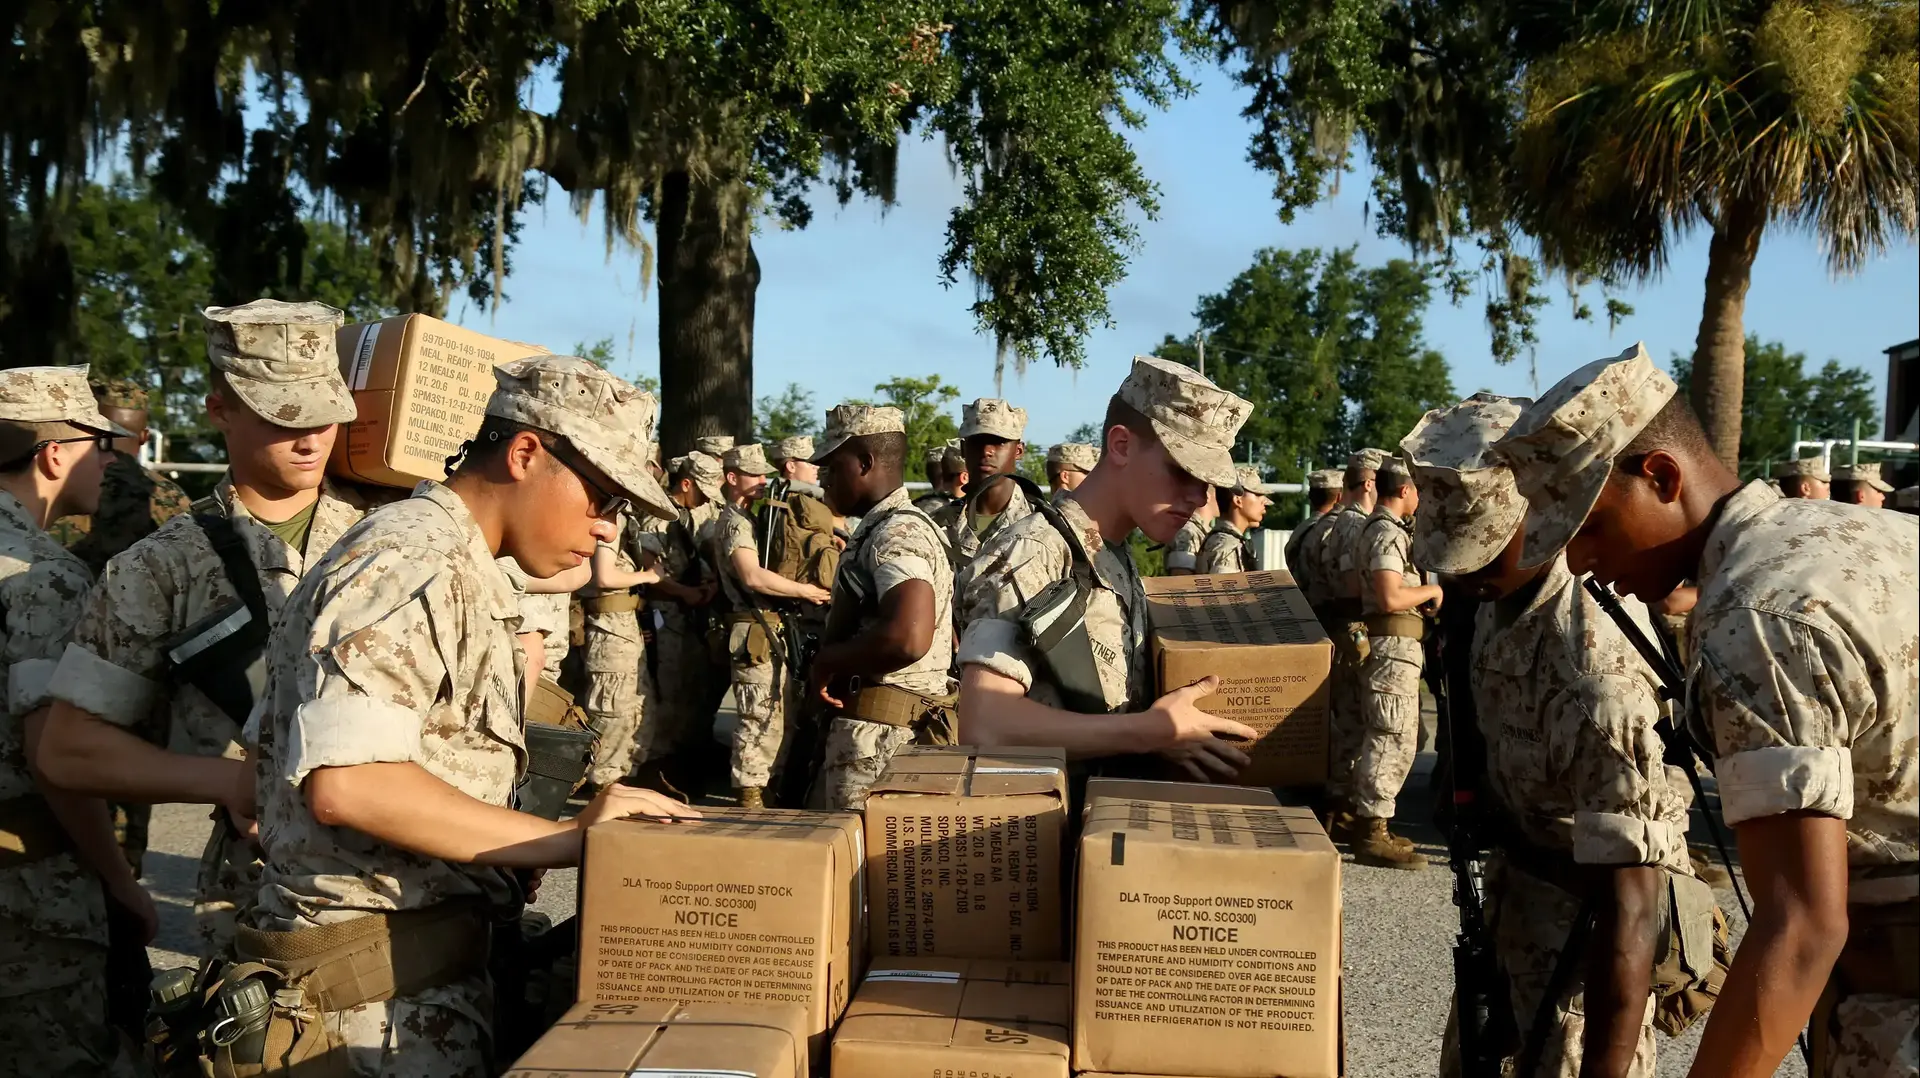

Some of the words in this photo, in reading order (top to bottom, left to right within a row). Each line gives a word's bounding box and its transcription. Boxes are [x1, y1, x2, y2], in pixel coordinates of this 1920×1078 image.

[422, 333, 495, 361] 8970-00-149-1094
[420, 347, 443, 361] MEAL,
[446, 354, 472, 368] READY
[477, 363, 486, 372] TO
[418, 361, 428, 370] 12
[429, 364, 455, 378] MEALS
[455, 372, 468, 382] A/A
[415, 375, 428, 386] WT.
[430, 379, 448, 391] 20.6
[458, 387, 470, 397] CU.
[474, 391, 489, 403] 0.8
[410, 403, 447, 421] SOPAKCO,
[449, 413, 465, 425] INC.
[406, 431, 421, 442] U.S.
[408, 417, 445, 435] MULLINS,
[447, 427, 462, 438] S.C.
[903, 817, 913, 836] U.S.
[973, 816, 984, 835] WT.
[990, 816, 1001, 829] 12
[921, 817, 932, 865] MULLINS,
[938, 816, 949, 864] SOPAKCO,
[973, 835, 984, 857] 20.6
[990, 829, 1001, 864] MEALS
[886, 817, 897, 885] COMMERCIAL
[956, 816, 967, 913] SPM3S1-12-D-Z108
[1009, 851, 1019, 883] READY
[903, 840, 914, 910] GOVERNMENT
[921, 869, 931, 887] S.C.
[939, 869, 949, 888] INC.
[974, 874, 984, 889] CU.
[991, 867, 1001, 882] A/A
[645, 879, 673, 891] Troop
[675, 880, 713, 892] Support
[716, 883, 755, 894] OWNED
[758, 886, 793, 897] STOCK
[1010, 892, 1019, 902] TO
[695, 897, 712, 906] NO.
[887, 889, 898, 926] RESALE
[974, 895, 984, 910] 0.8
[1120, 892, 1140, 902] DLA
[1143, 893, 1171, 905] Troop
[1173, 895, 1212, 907] Support
[1215, 897, 1254, 908] OWNED
[1257, 899, 1293, 910] STOCK
[675, 911, 738, 927] NOTICE
[1158, 909, 1190, 921] (ACCT.
[1194, 911, 1211, 921] NO.
[601, 925, 618, 933] THIS
[620, 926, 660, 935] PRODUCT
[680, 930, 702, 938] BEEN
[705, 931, 726, 939] HELD
[728, 933, 757, 941] UNDER
[759, 934, 815, 944] CONTROLLED
[888, 930, 898, 938] IS
[1174, 925, 1238, 943] NOTICE
[600, 936, 665, 947] TEMPERATURE
[689, 942, 733, 951] HUMIDITY
[736, 945, 792, 955] CONDITIONS
[1097, 941, 1116, 949] THIS
[1118, 942, 1159, 951] PRODUCT
[1161, 944, 1178, 952] HAS
[1180, 945, 1202, 954] BEEN
[1204, 947, 1226, 955] HELD
[1228, 948, 1258, 956] UNDER
[1260, 949, 1316, 960] CONTROLLED
[599, 948, 633, 957] SHOULD
[669, 952, 726, 962] CONSIDERED
[726, 956, 751, 964] OVER
[773, 958, 814, 968] BECAUSE
[1097, 953, 1164, 964] TEMPERATURE
[1167, 957, 1186, 965] AND
[1189, 958, 1234, 967] HUMIDITY
[1237, 960, 1294, 971] CONDITIONS
[1297, 964, 1316, 972] AND
[612, 960, 633, 968] DATE
[649, 963, 672, 971] PACK
[714, 966, 736, 975] DATE
[752, 969, 775, 977] PACK
[777, 970, 813, 979] SHOULD
[1097, 964, 1133, 974] SHOULD
[1135, 967, 1153, 975] NOT
[1155, 968, 1167, 976] BE
[1169, 969, 1226, 979] CONSIDERED
[1228, 972, 1252, 980] OVER
[1254, 973, 1272, 981] AGE
[1275, 974, 1316, 984] BECAUSE
[597, 982, 642, 992] ISSUANCE
[669, 987, 725, 997] UTILIZATION
[765, 993, 811, 1002] PRODUCT.
[648, 974, 707, 984] CONTROLLING
[709, 978, 742, 987] FACTOR
[755, 981, 812, 991] DETERMINING
[1097, 976, 1108, 984] OF
[1111, 977, 1132, 986] DATE
[1135, 979, 1147, 987] OF
[1149, 979, 1172, 988] PACK
[1174, 981, 1193, 990] AND
[1196, 982, 1212, 990] THE
[1215, 983, 1237, 992] DATE
[1239, 984, 1251, 992] OF
[1253, 985, 1276, 994] PACK
[1279, 987, 1316, 996] SHOULD
[1096, 988, 1114, 996] NOT
[1116, 989, 1127, 997] BE
[1129, 990, 1145, 998] THE
[1147, 991, 1207, 1002] CONTROLLING
[1210, 995, 1243, 1004] FACTOR
[1256, 997, 1315, 1008] DETERMINING
[1096, 1000, 1143, 1010] ISSUANCE
[1146, 1003, 1166, 1011] AND
[1169, 1004, 1226, 1015] UTILIZATION
[1229, 1008, 1242, 1016] OF
[1245, 1009, 1263, 1017] THE
[1267, 1010, 1315, 1020] PRODUCT.
[1096, 1012, 1140, 1022] FURTHER
[1144, 1015, 1221, 1026] REFRIGERATION
[1261, 1022, 1314, 1031] REQUIRED.
